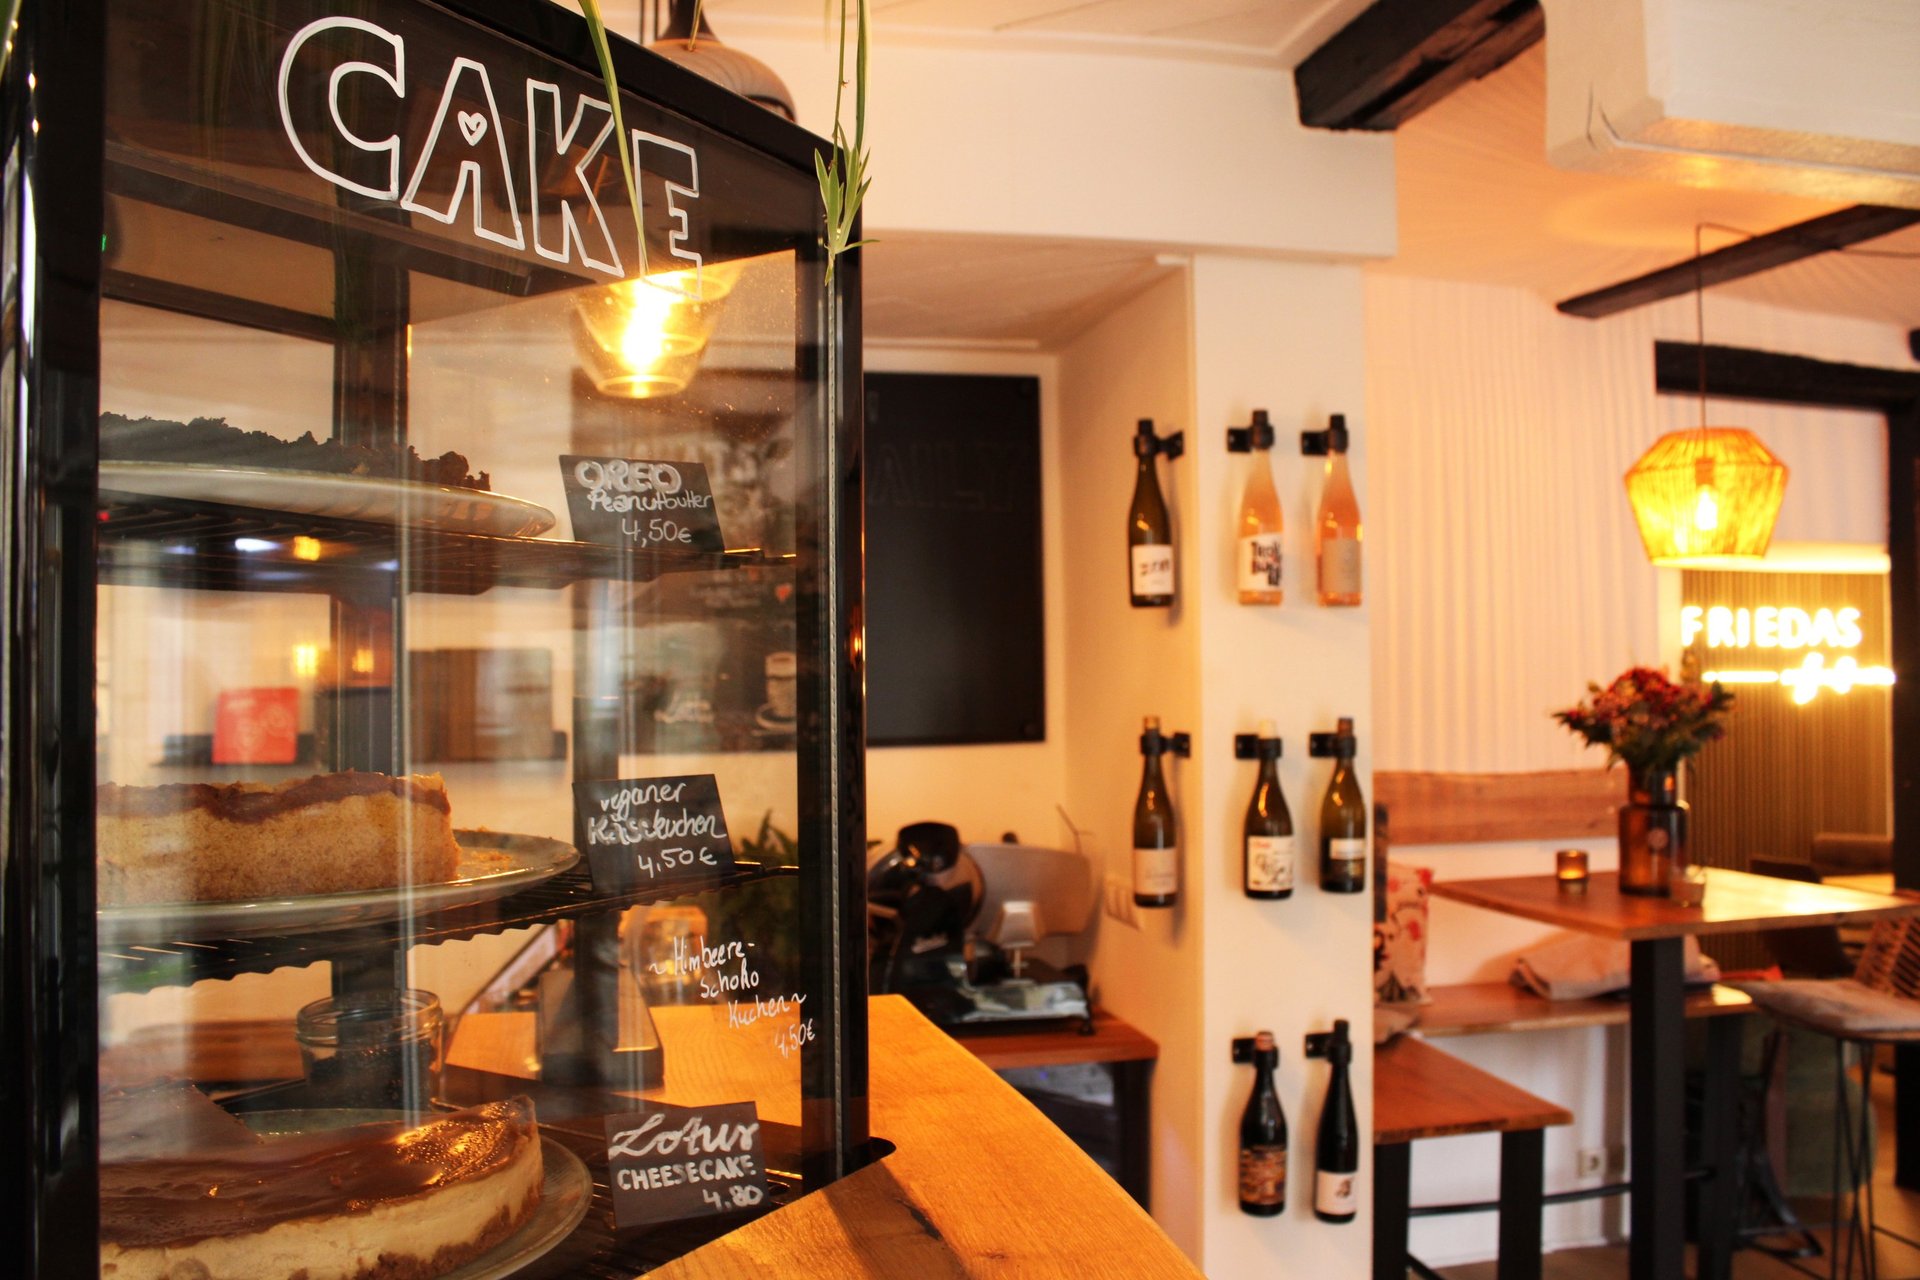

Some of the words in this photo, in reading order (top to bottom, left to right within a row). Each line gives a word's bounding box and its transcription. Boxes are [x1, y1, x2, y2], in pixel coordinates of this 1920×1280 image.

[278, 16, 703, 301] CAKE
[574, 459, 682, 494] OREO
[587, 488, 712, 513] Peanutbutter
[621, 518, 692, 548] 4,50€
[1680, 605, 1862, 649] FRIEDAS
[600, 782, 687, 822] veganer
[728, 994, 790, 1029] Kuchen
